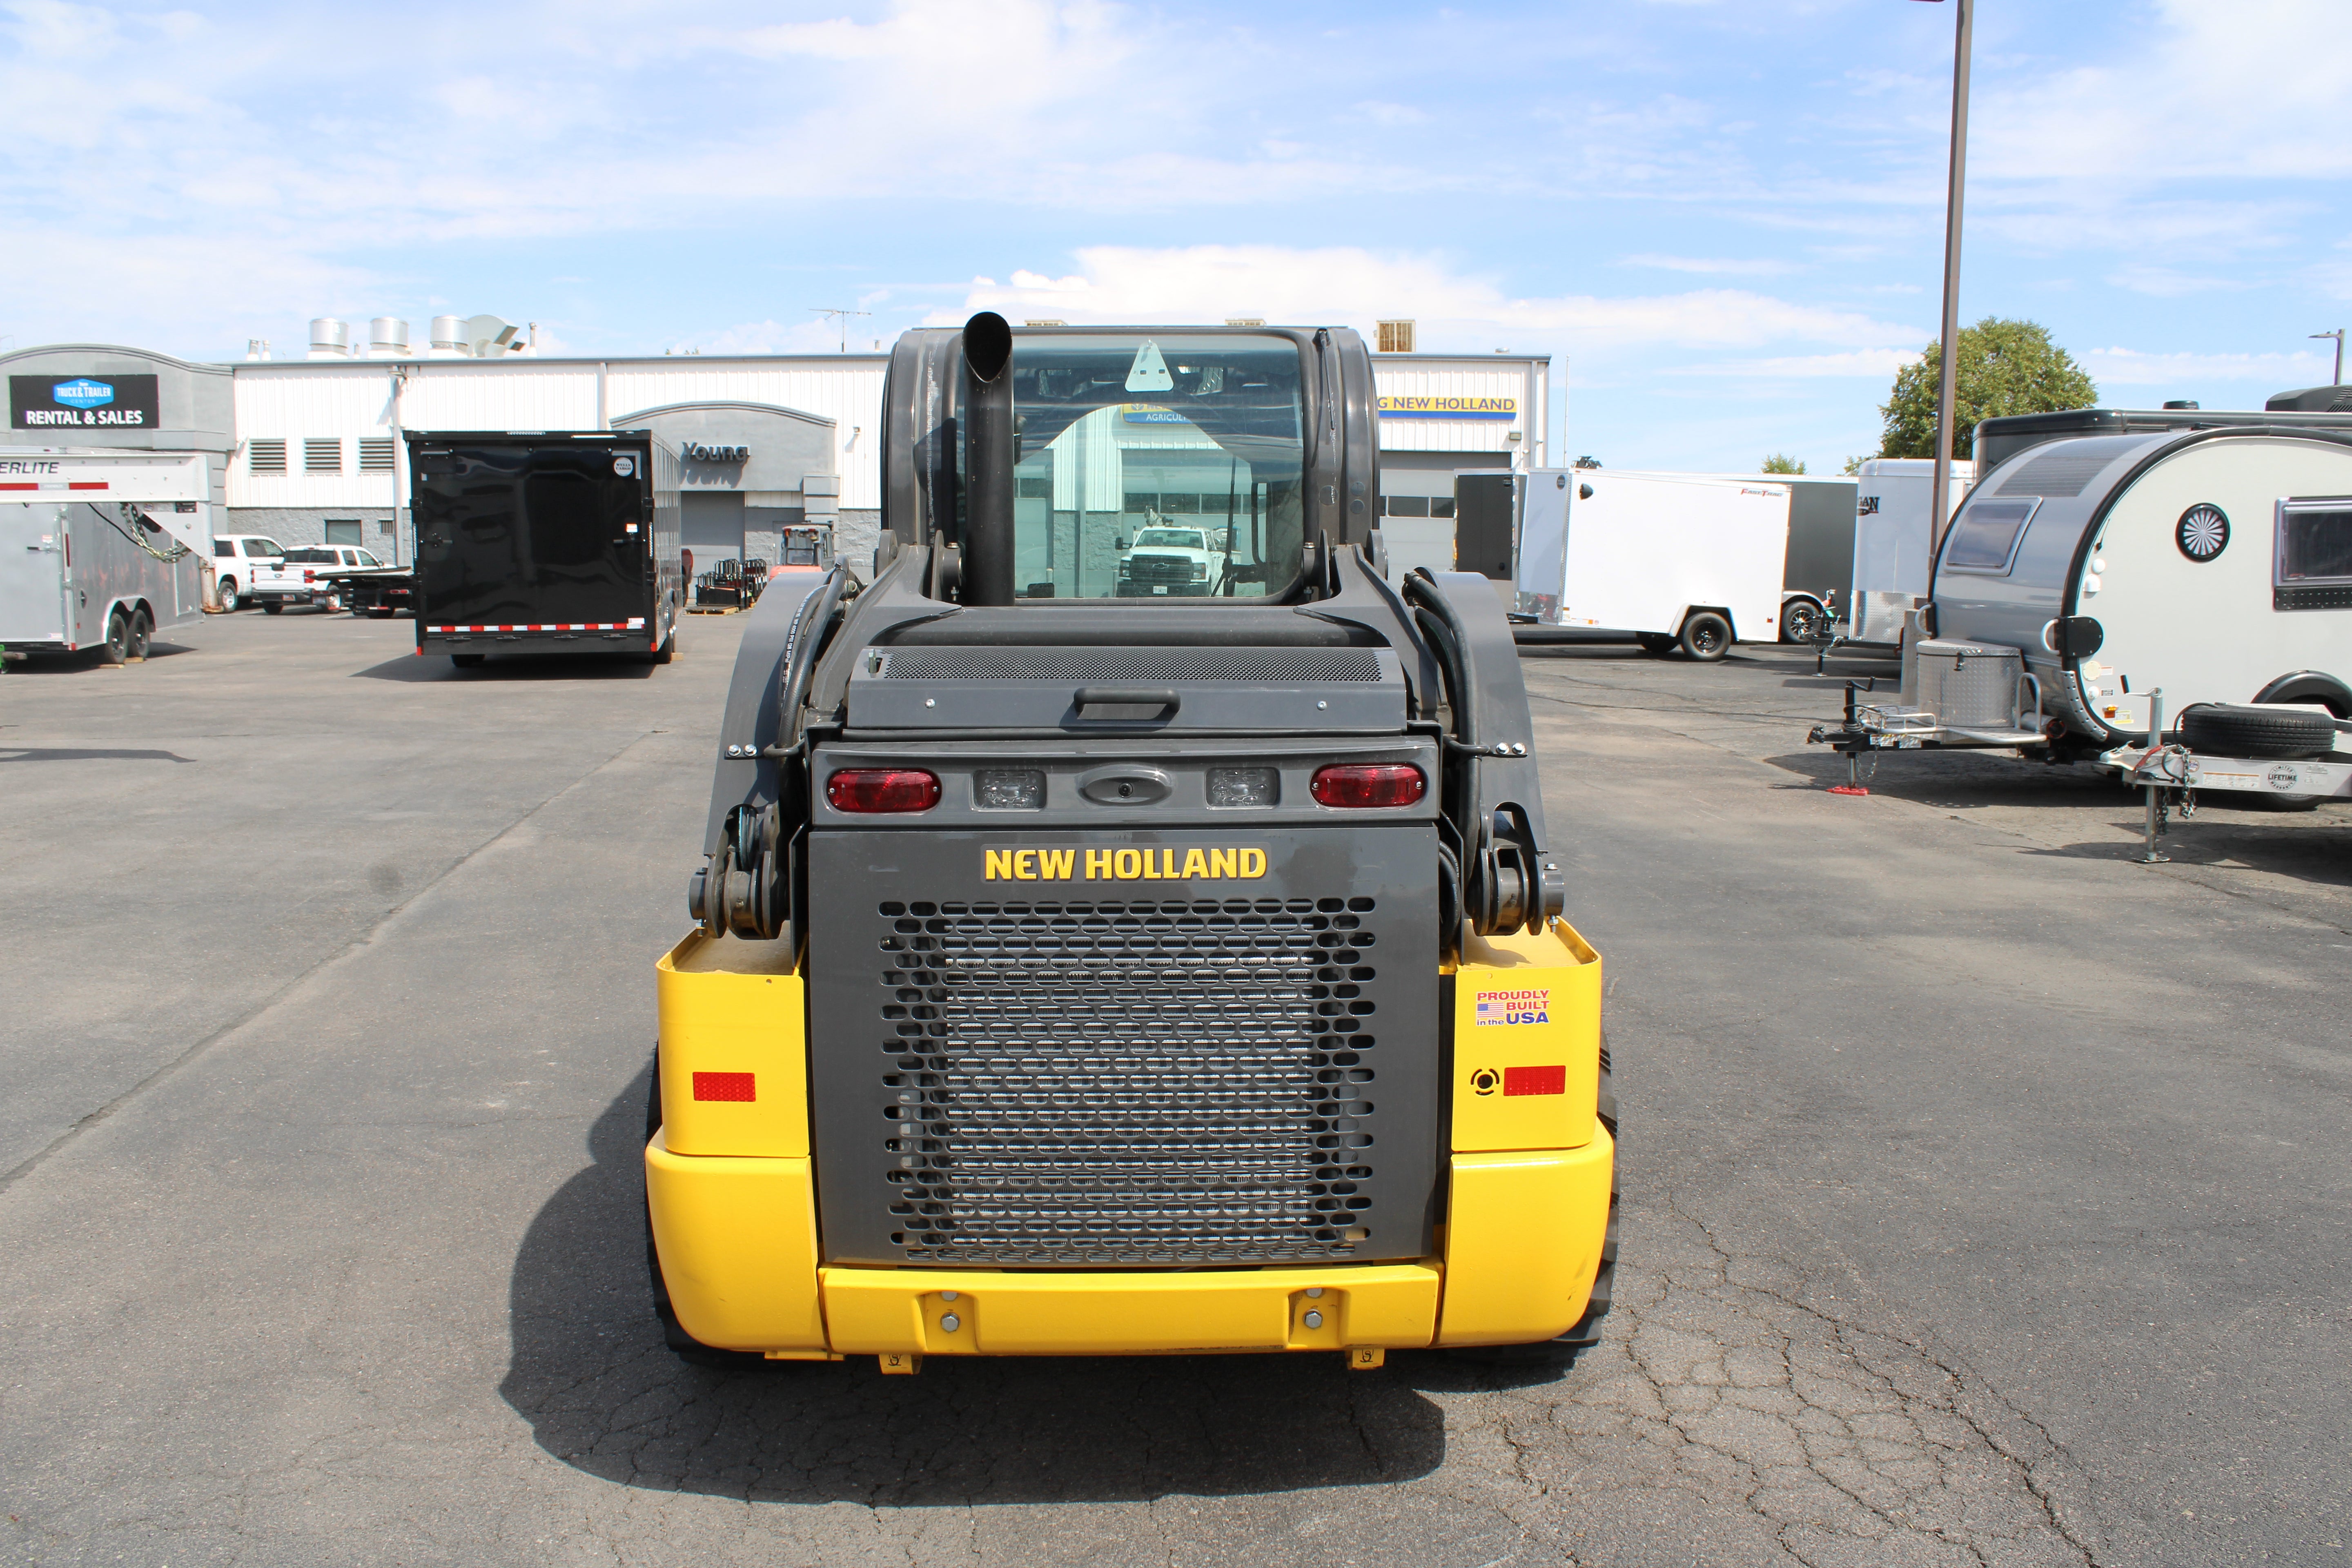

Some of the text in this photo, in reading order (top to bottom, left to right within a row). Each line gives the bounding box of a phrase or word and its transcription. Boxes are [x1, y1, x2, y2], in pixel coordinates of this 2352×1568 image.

[57, 387, 111, 398] TRUCK & TRAILER
[1394, 398, 1430, 409] NEW
[1435, 398, 1515, 410] HOLLAND
[26, 410, 143, 425] RENTAL & SALES
[682, 442, 748, 465] Young
[2270, 781, 2294, 789] WARRANTY
[985, 849, 1267, 879] NEW HOLLAND
[1477, 990, 1549, 1001] PROUDLY
[1506, 1001, 1549, 1010] BUILT
[1506, 1012, 1549, 1025] USA
